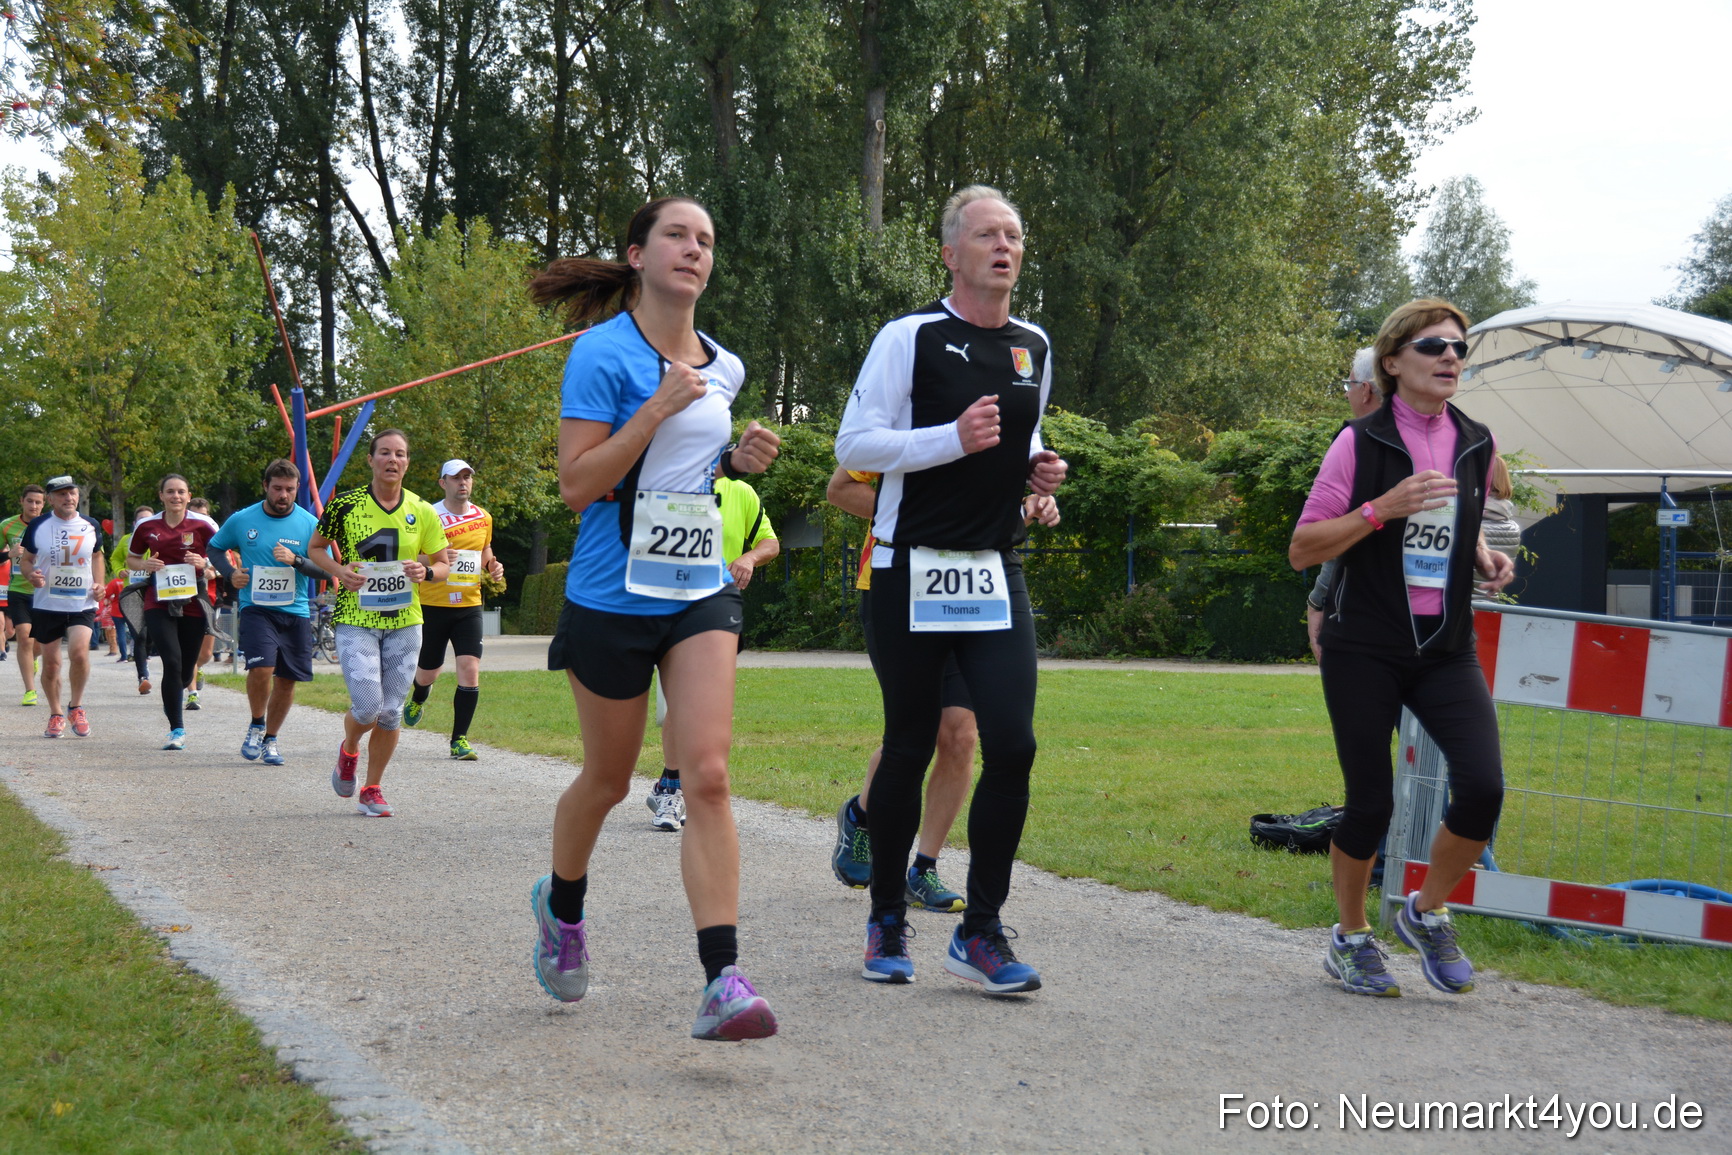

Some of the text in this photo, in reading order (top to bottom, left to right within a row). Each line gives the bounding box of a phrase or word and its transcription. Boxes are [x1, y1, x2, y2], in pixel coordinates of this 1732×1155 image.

[446, 527, 467, 539] MAX
[468, 520, 489, 532] BÖGL
[647, 525, 714, 559] 2226
[1403, 522, 1451, 552] 256
[456, 560, 475, 573] 269
[1414, 559, 1445, 573] Margit
[54, 575, 83, 587] 2420
[165, 575, 187, 587] 165
[676, 569, 691, 582] Evi
[925, 567, 995, 595] 2013
[258, 578, 289, 591] 2357
[367, 575, 406, 593] 2686
[941, 605, 981, 615] Thomas
